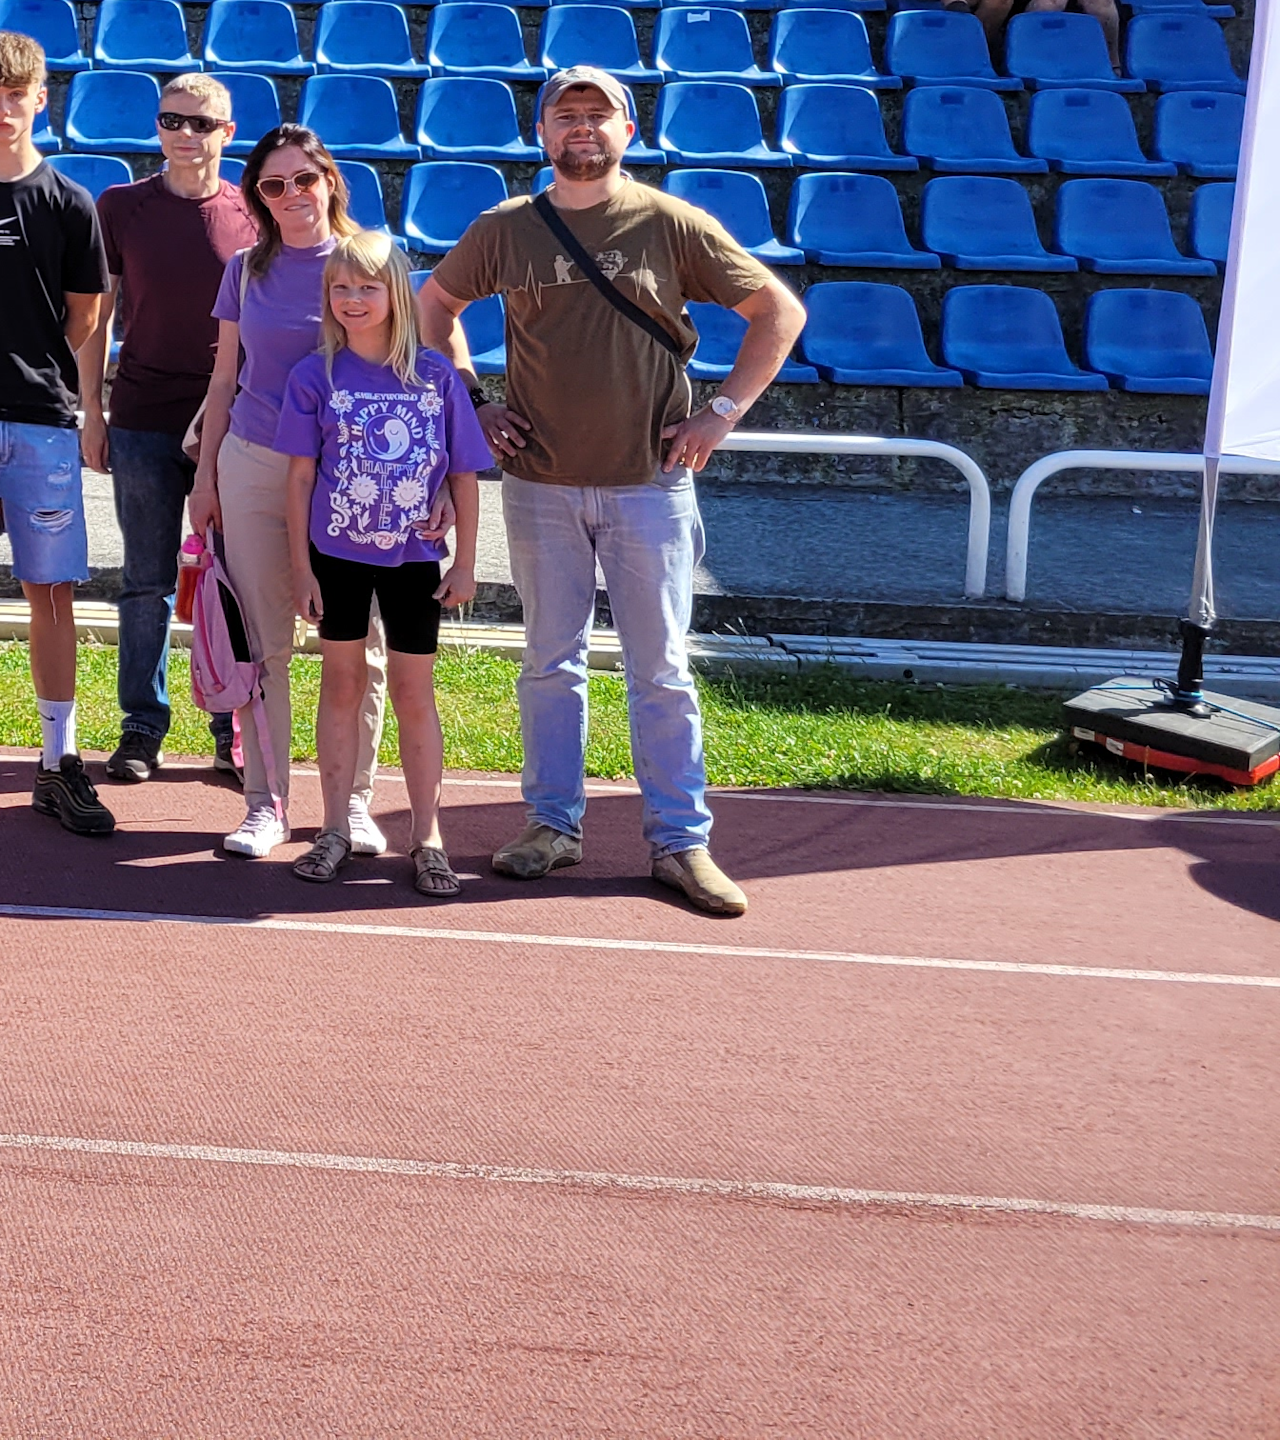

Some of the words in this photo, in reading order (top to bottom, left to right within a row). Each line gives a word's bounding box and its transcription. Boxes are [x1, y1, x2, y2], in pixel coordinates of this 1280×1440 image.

[353, 391, 418, 402] SMILEYWORLD
[350, 401, 389, 437] HAPPY
[393, 404, 424, 440] MIND
[361, 459, 416, 477] HAPPY
[377, 474, 393, 530] LIFE
